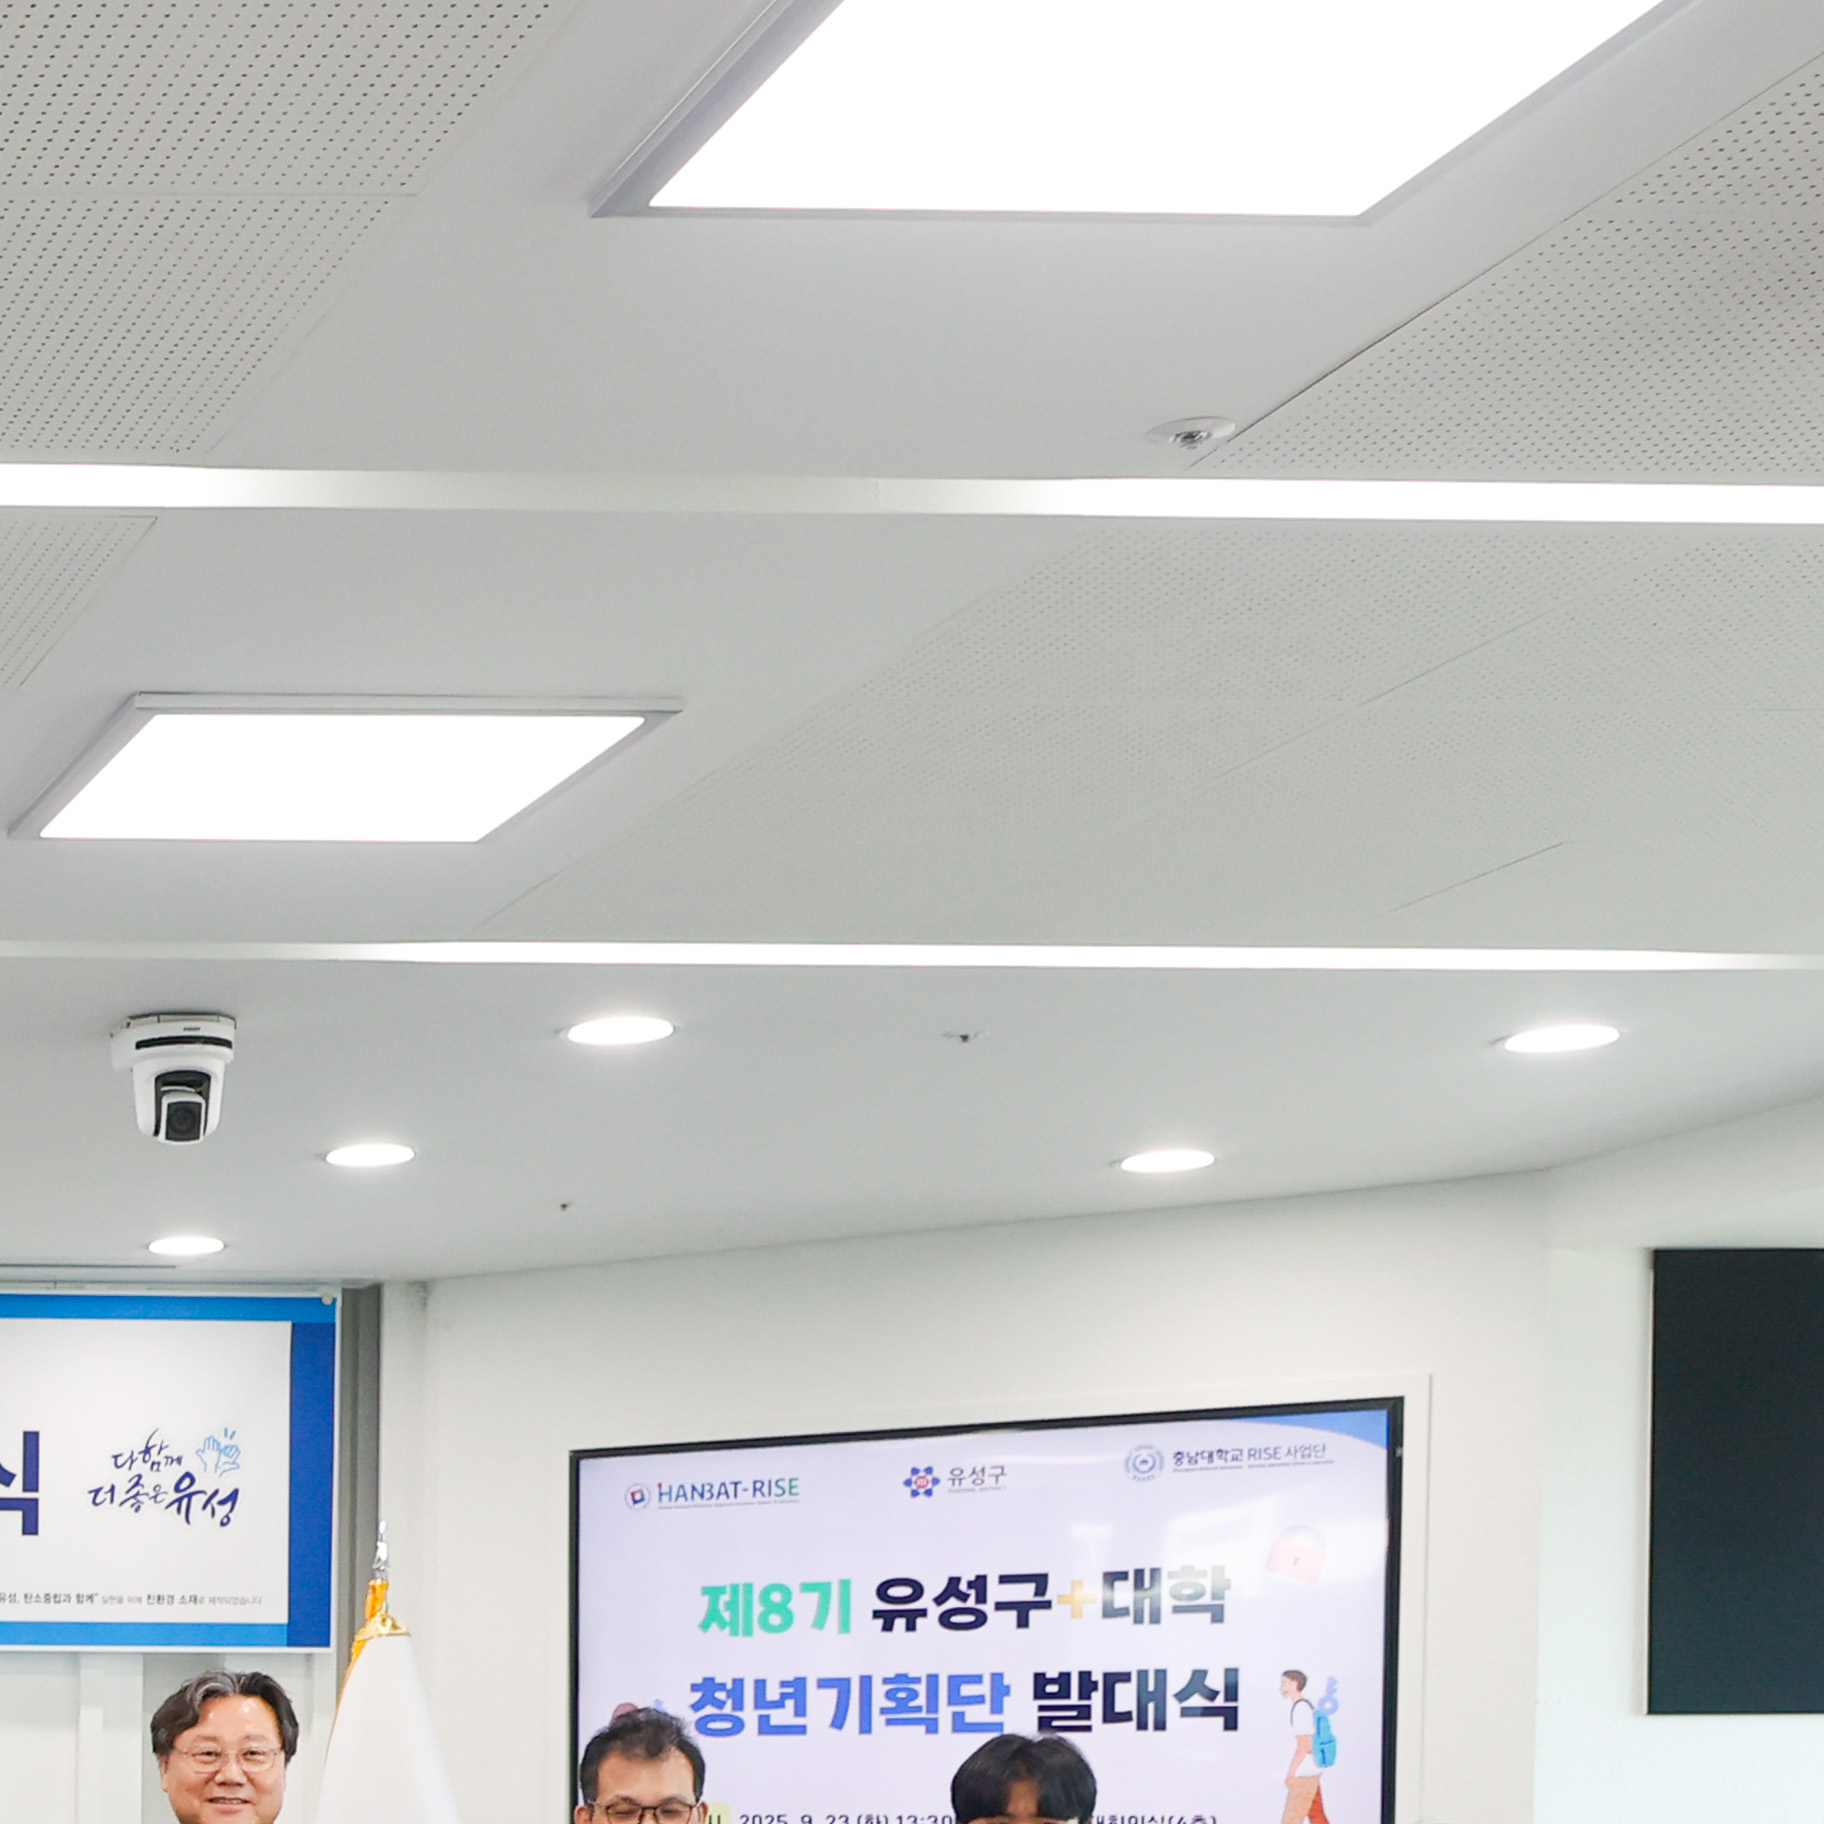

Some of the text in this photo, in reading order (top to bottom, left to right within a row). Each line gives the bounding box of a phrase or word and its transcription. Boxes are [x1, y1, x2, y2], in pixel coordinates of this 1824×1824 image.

[111, 1428, 184, 1473] 다함께
[946, 1465, 1008, 1487] 유성구
[1172, 1447, 1244, 1468] 충남대학교
[1246, 1446, 1283, 1462] RISE
[1284, 1442, 1328, 1460] 사업단
[88, 1483, 116, 1507] 더
[164, 1471, 240, 1528] 유성
[698, 1578, 852, 1637] 제8기
[688, 1666, 1241, 1739] 청년기획단 발대식
